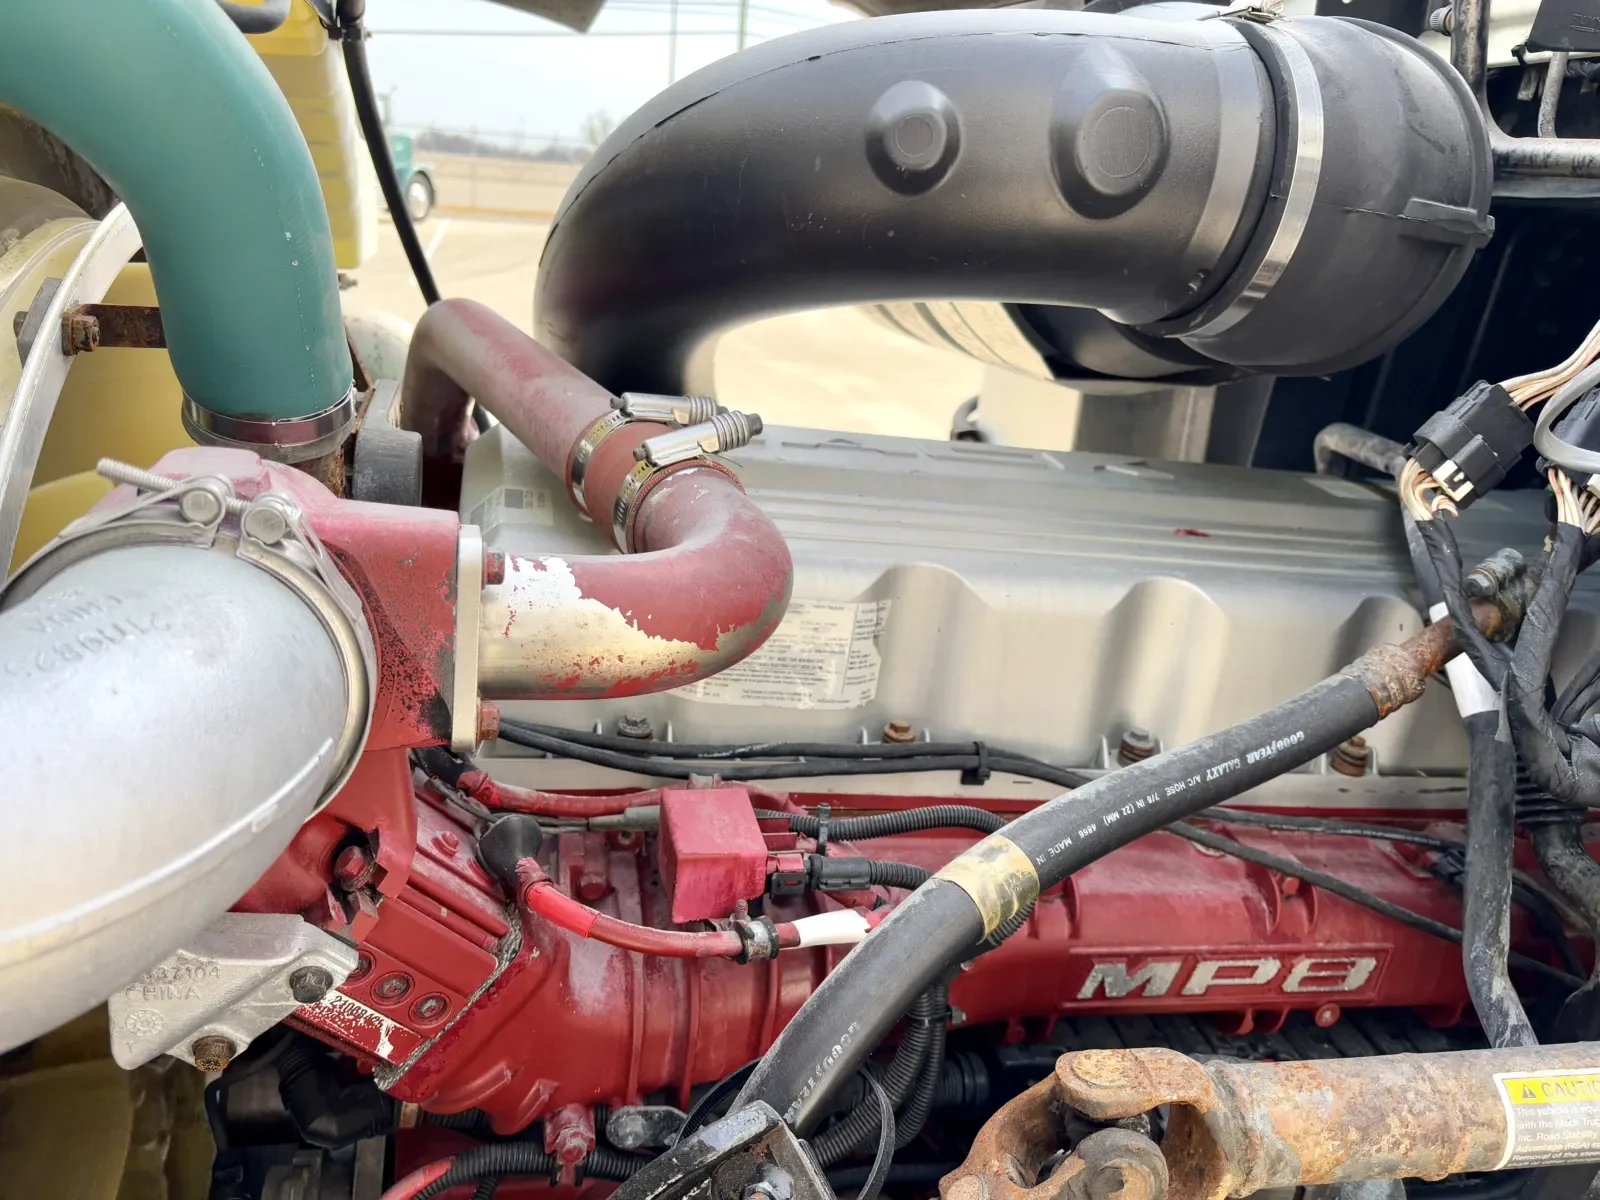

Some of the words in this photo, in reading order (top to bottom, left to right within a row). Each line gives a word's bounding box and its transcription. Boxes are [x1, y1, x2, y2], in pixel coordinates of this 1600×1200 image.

[1246, 730, 1304, 765] GOODYEAR
[1206, 758, 1241, 782] GALAXY
[1188, 773, 1202, 787] A/C
[1165, 782, 1186, 796] HOSE
[1119, 802, 1134, 816] (22
[1135, 797, 1145, 809] IN
[1103, 809, 1121, 826] MM)
[1048, 837, 1073, 857] MADE
[1036, 853, 1047, 866] IN
[1076, 955, 1378, 1000] MP8
[125, 984, 202, 1001] CHINA
[1516, 1107, 1535, 1116] This
[1518, 1120, 1537, 1130] with
[1539, 1119, 1553, 1128] the
[1536, 1132, 1559, 1141] Road
